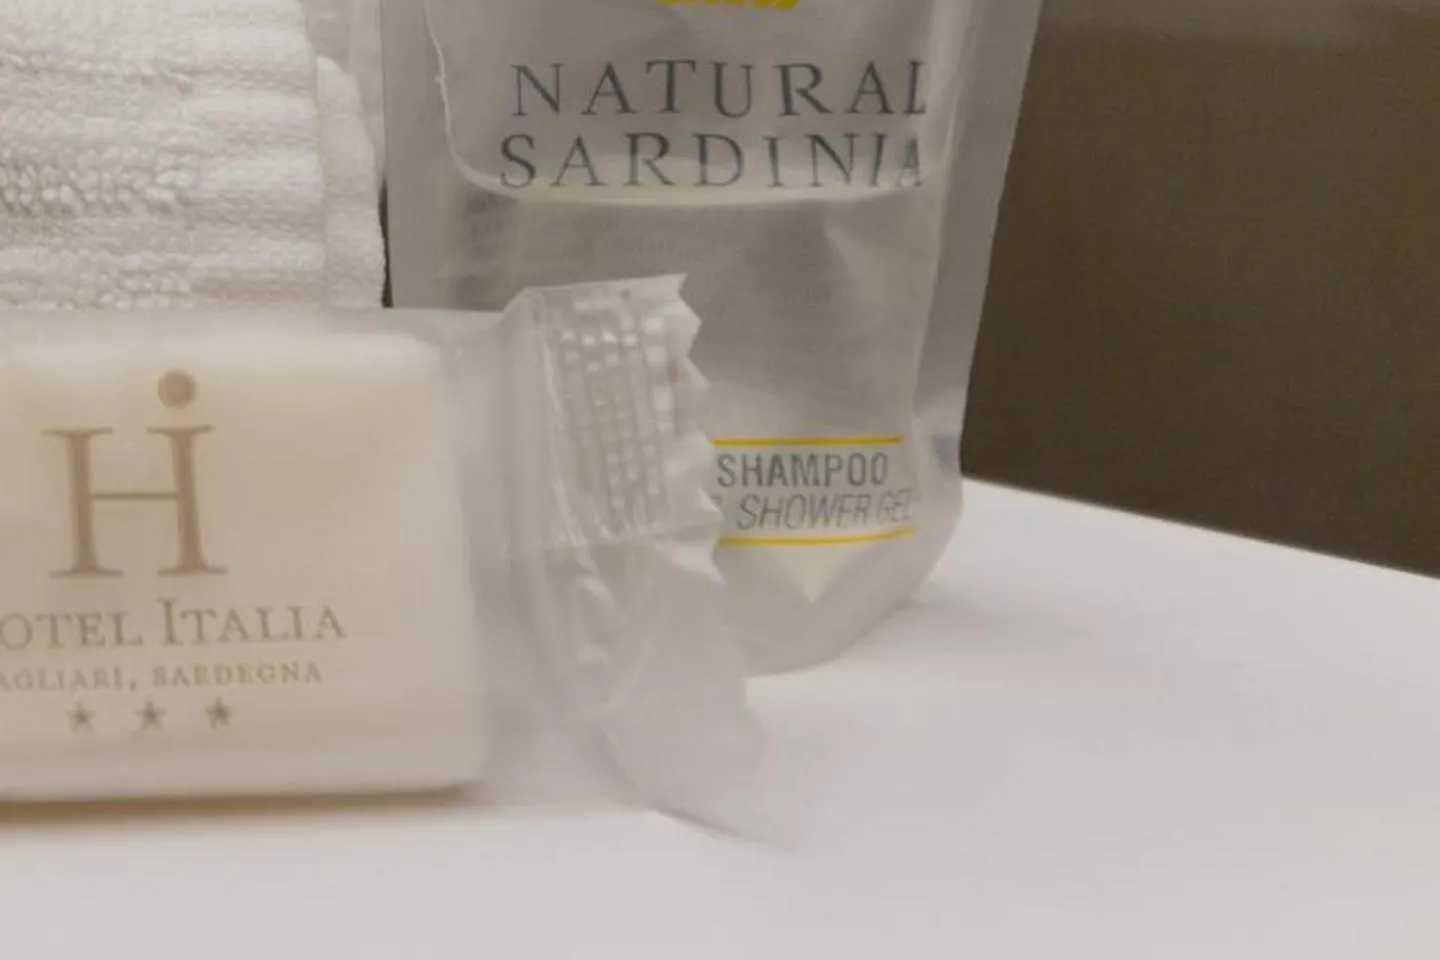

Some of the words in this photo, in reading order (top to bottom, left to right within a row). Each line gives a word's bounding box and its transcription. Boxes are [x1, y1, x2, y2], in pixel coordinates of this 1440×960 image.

[509, 58, 927, 118] NATURAL
[499, 131, 923, 189] SARDINIA
[715, 451, 889, 488] SHAMPOO
[737, 493, 871, 530] SHOWER
[151, 660, 325, 690] SARDEGNA
